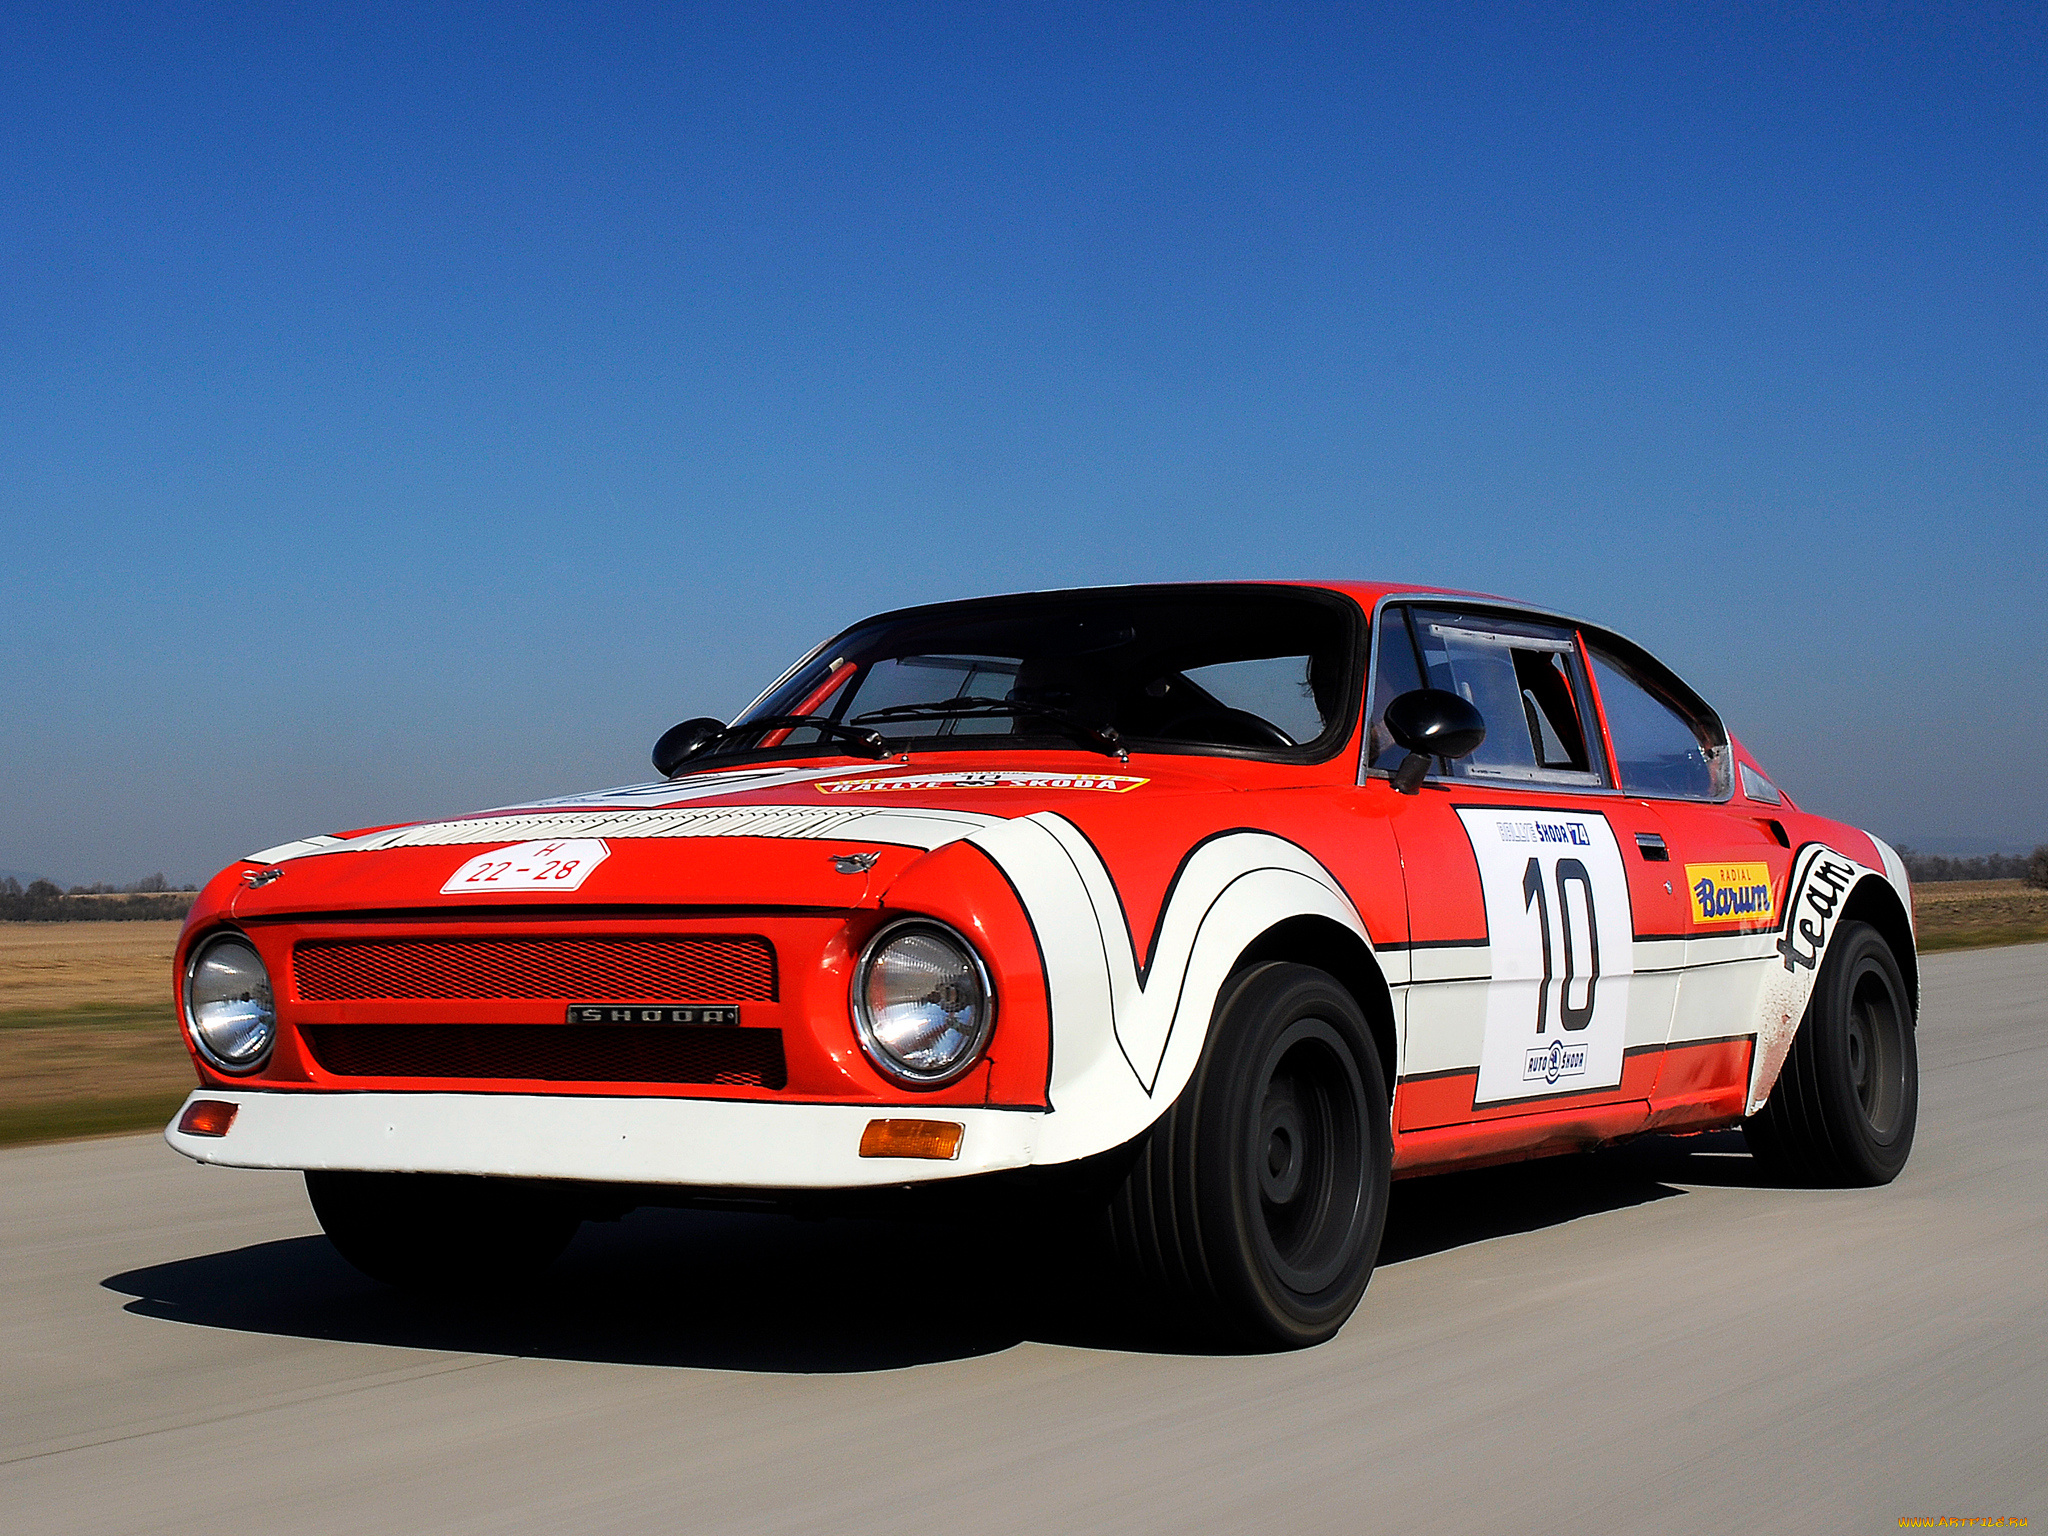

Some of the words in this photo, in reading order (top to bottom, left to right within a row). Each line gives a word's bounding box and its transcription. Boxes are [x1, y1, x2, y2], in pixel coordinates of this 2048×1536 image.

[831, 781, 942, 792] RALLYE
[534, 843, 566, 857] H
[1720, 869, 1751, 881] RADIAL
[1693, 878, 1770, 918] Barum
[1776, 849, 1855, 974] team
[1523, 857, 1600, 1034] 10
[1528, 1056, 1547, 1072] AUTO
